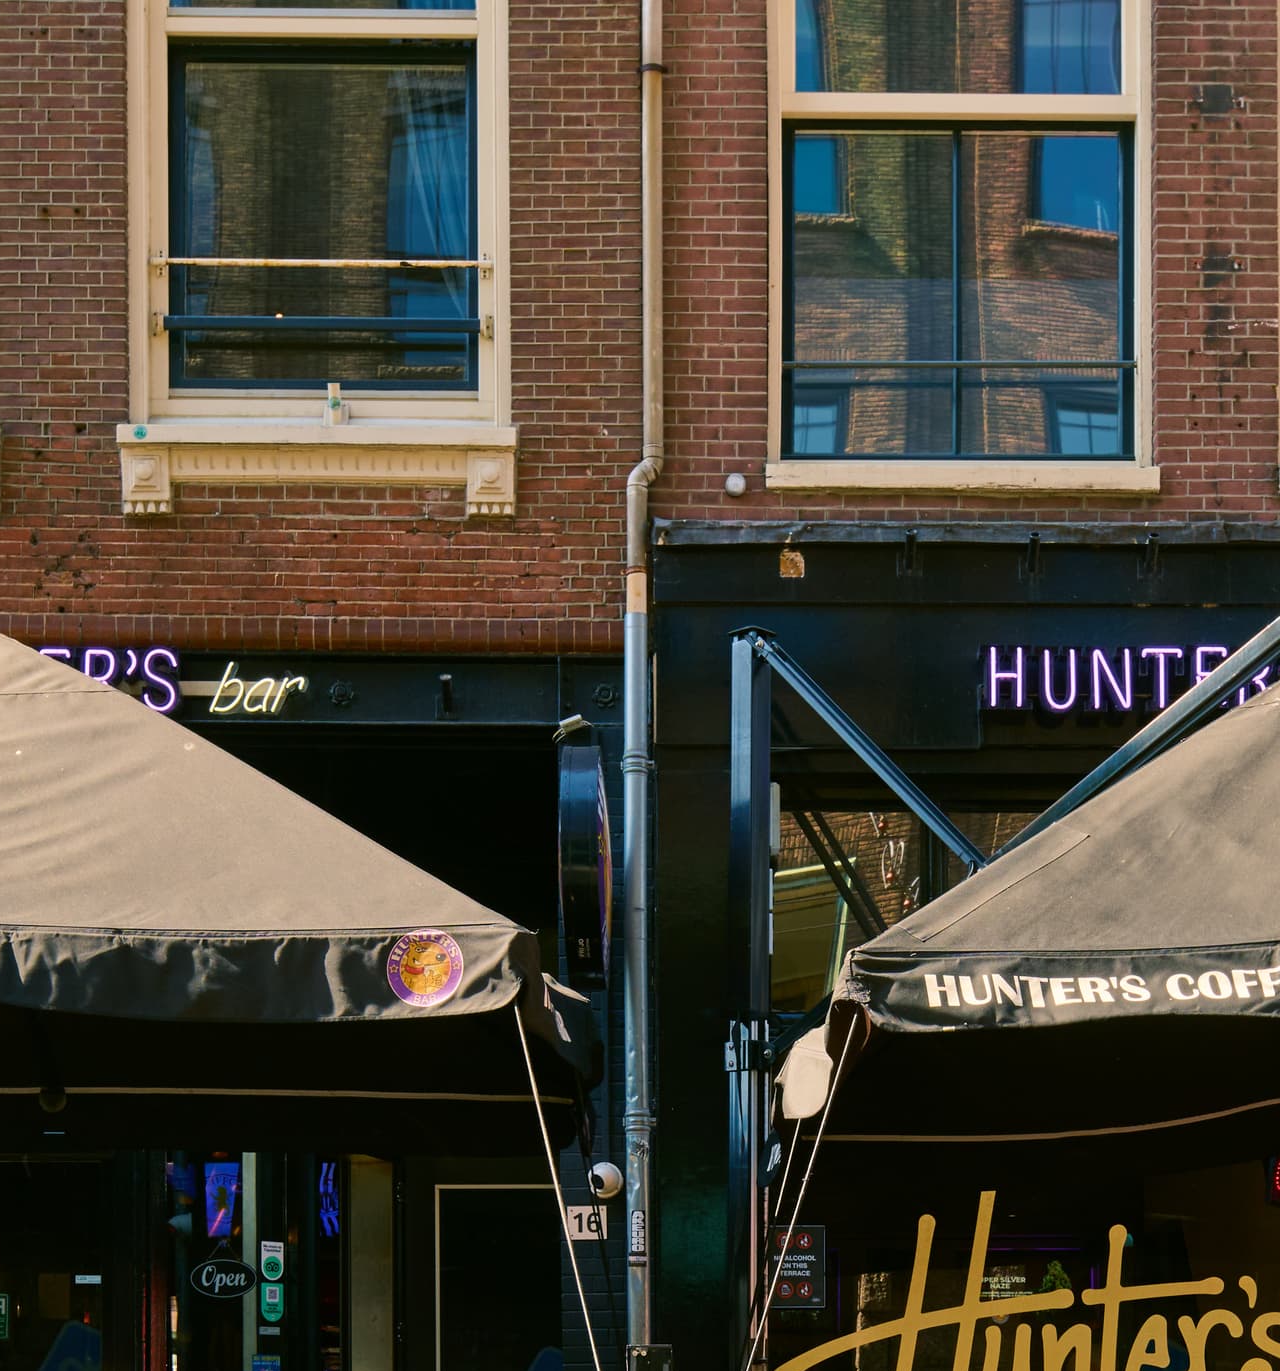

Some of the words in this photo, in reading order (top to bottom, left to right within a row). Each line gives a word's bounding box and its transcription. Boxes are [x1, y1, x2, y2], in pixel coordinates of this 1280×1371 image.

[209, 661, 305, 712] bar
[391, 931, 458, 961] HUNTER'S
[414, 994, 437, 1005] BAR
[924, 974, 1150, 1008] HUNTER'S
[573, 1212, 600, 1233] 16
[201, 1265, 247, 1294] Open
